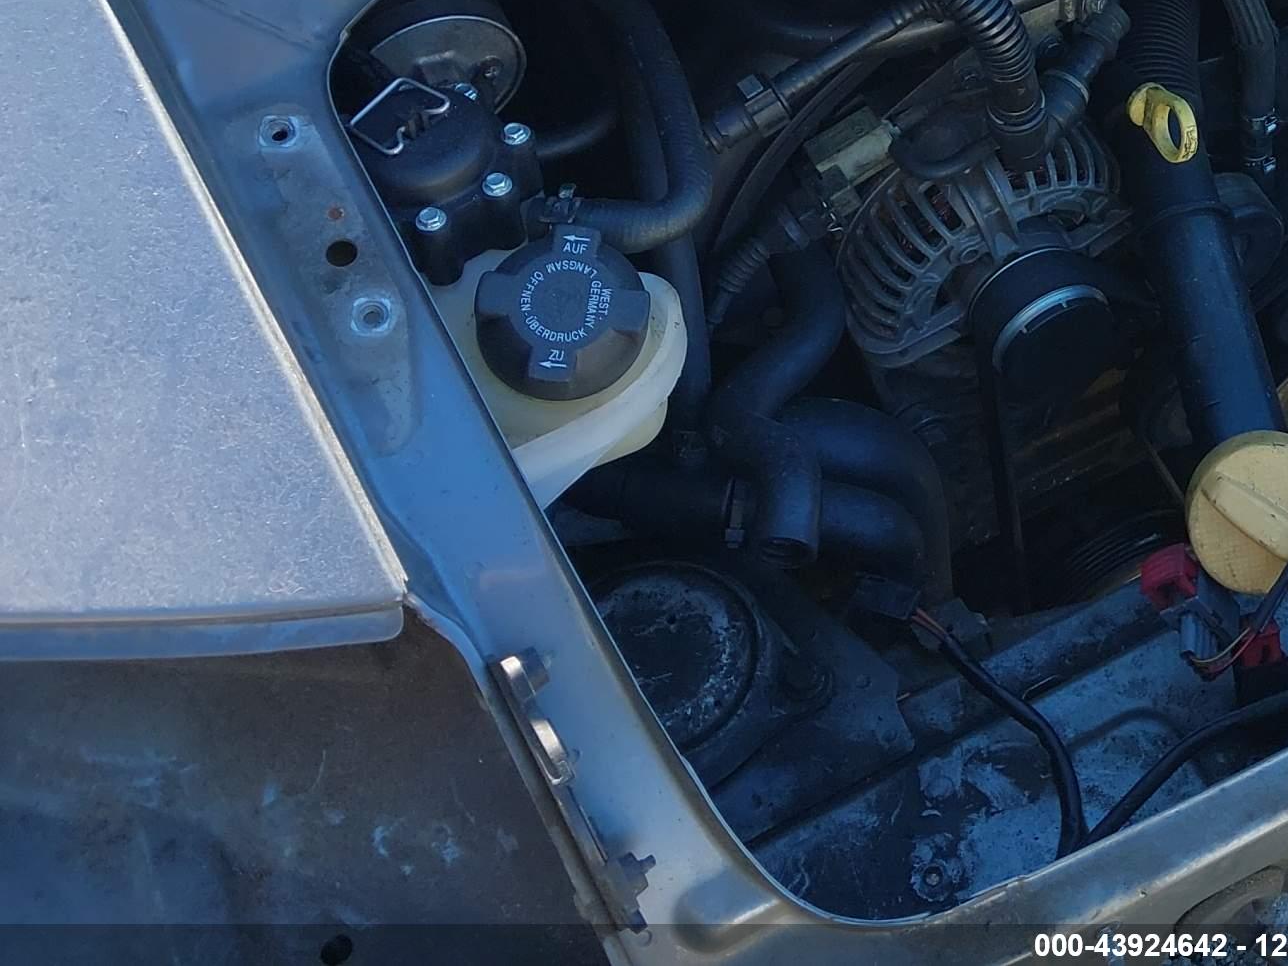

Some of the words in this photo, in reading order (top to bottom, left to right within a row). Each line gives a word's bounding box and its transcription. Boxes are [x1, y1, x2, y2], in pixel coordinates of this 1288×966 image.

[562, 241, 588, 255] AUF
[545, 260, 598, 279] LANGSAM
[584, 280, 602, 329] GERMANY
[548, 349, 565, 361] ZU
